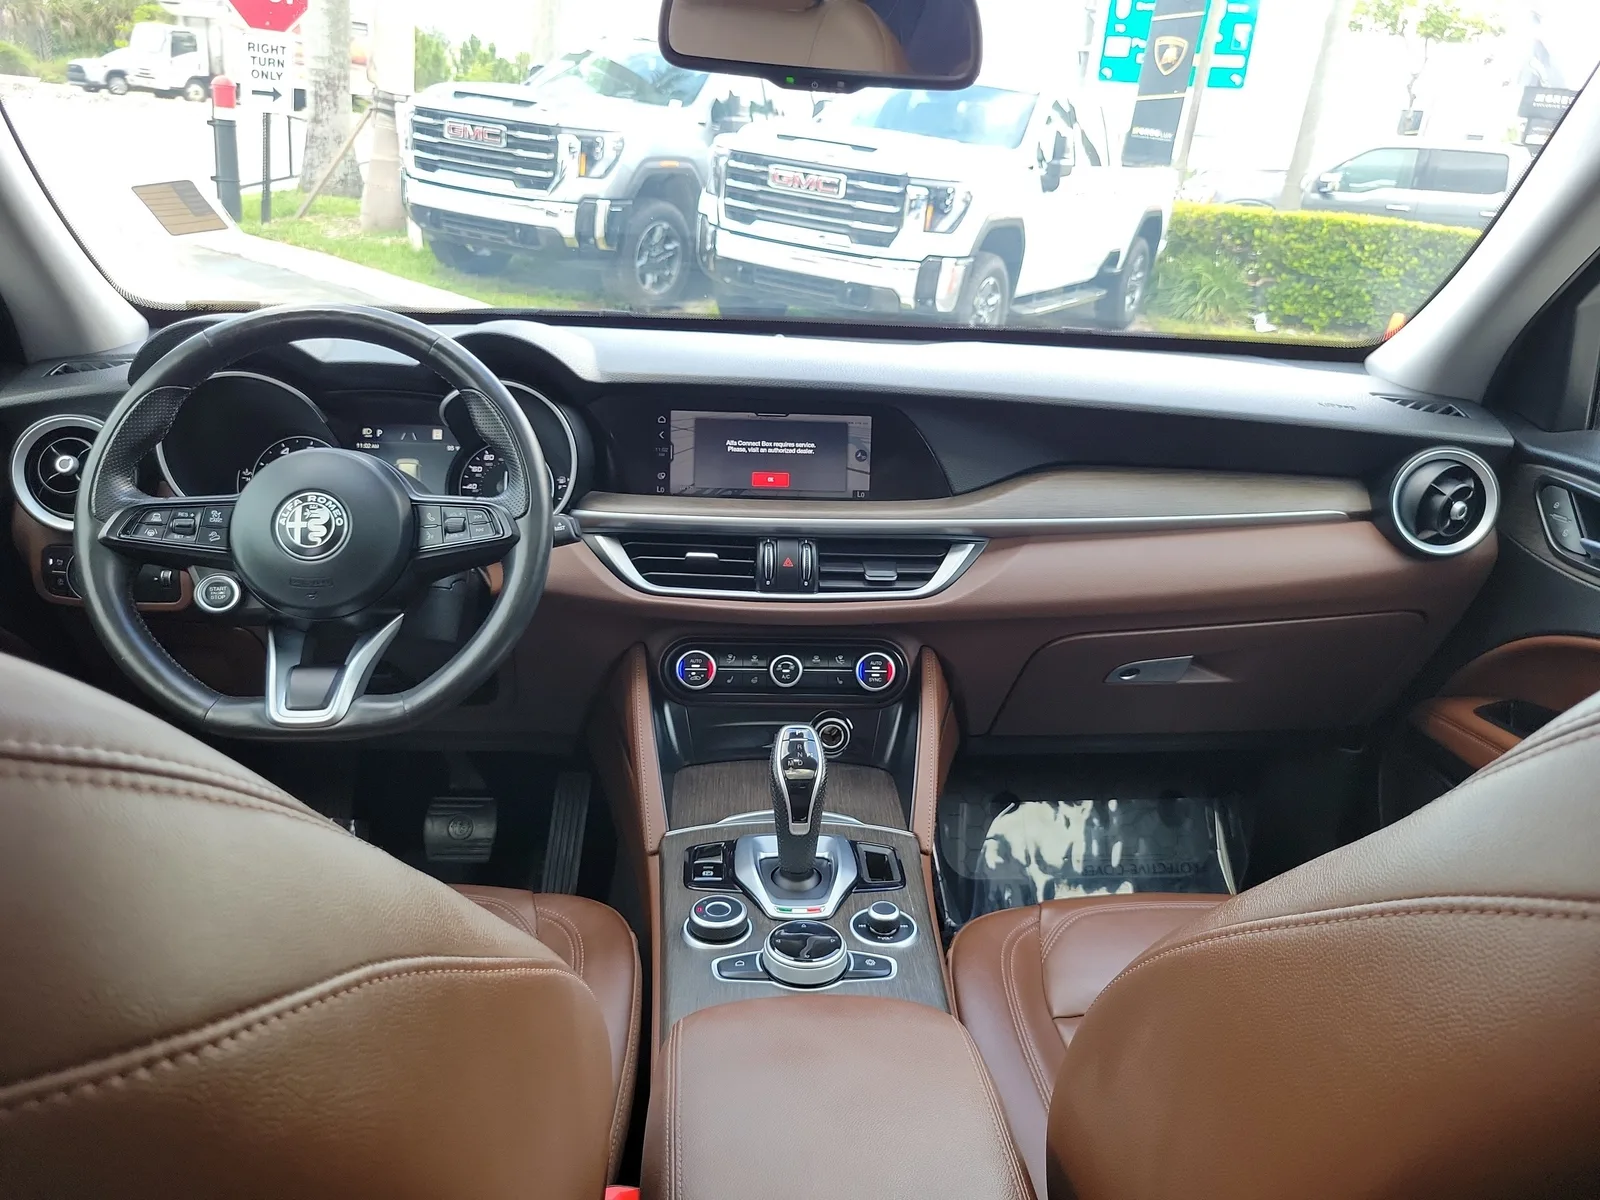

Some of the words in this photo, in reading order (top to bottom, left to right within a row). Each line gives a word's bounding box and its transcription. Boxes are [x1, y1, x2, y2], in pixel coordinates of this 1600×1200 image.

[247, 42, 287, 55] RIGHT
[250, 55, 285, 68] TURN
[251, 69, 283, 81] ONLY
[447, 122, 502, 146] GMC
[771, 168, 840, 196] GMC
[376, 428, 383, 438] P
[727, 446, 747, 454] Please,
[773, 441, 795, 449] requires
[280, 447, 290, 455] 4
[656, 485, 665, 493] Lo
[856, 490, 865, 498] Lo
[278, 498, 303, 526] ALFA
[307, 495, 344, 527] ROMEO
